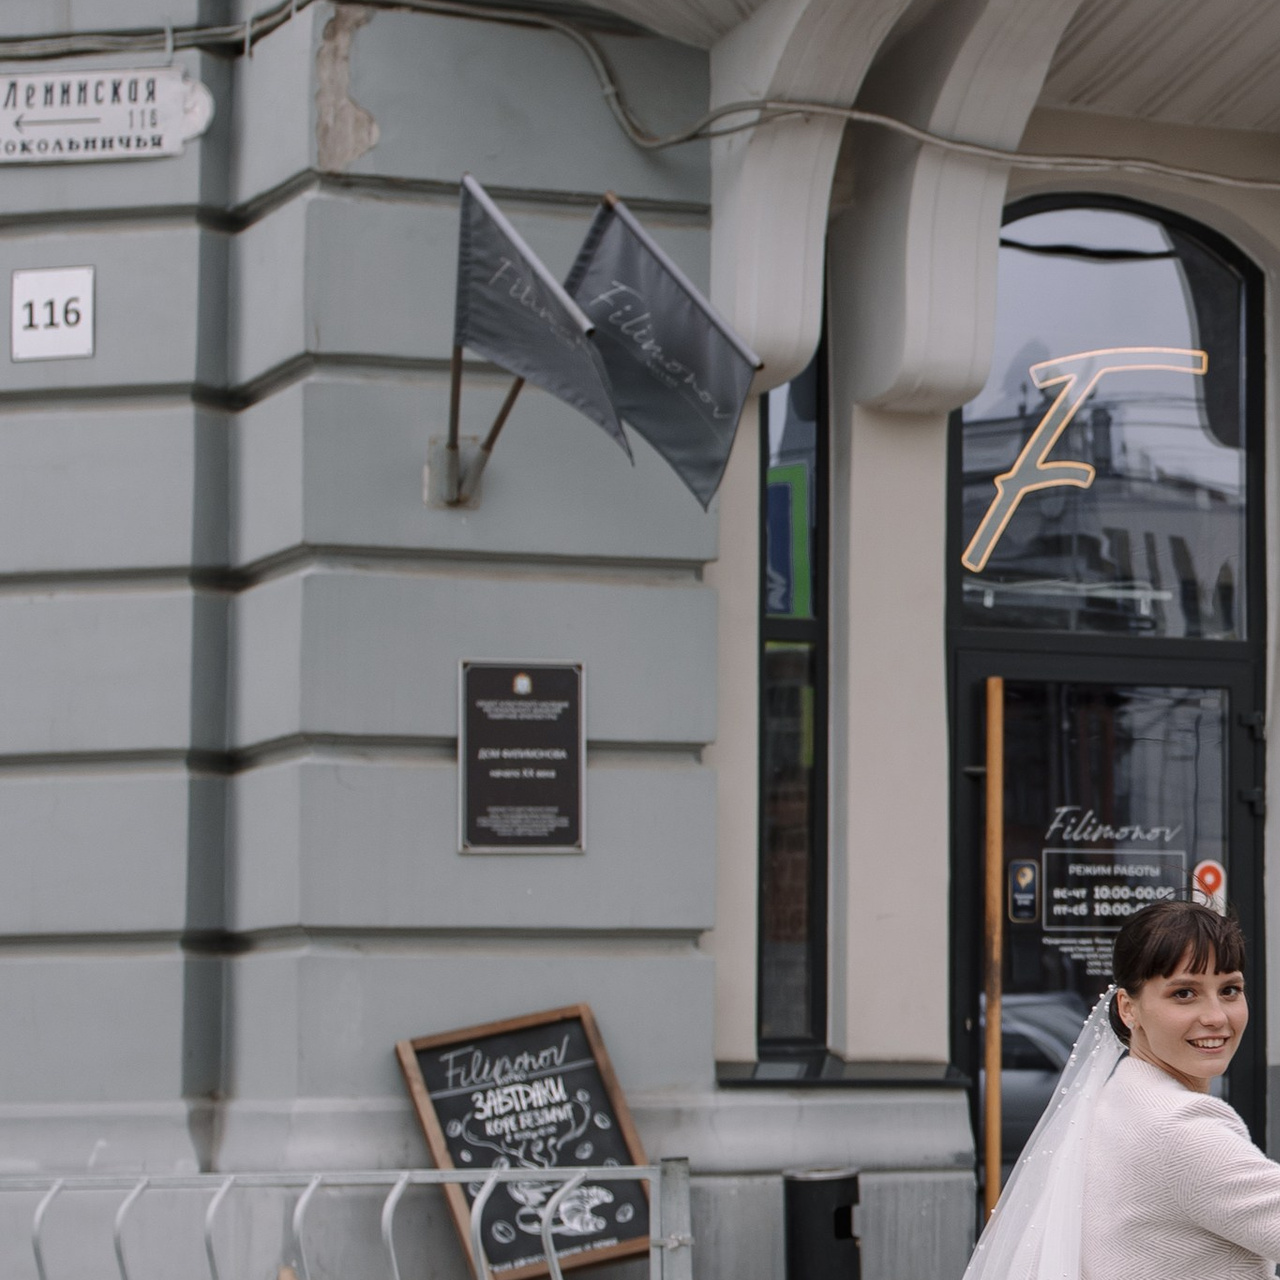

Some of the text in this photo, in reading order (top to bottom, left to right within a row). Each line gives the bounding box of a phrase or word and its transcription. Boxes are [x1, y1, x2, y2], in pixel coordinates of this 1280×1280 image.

[4, 77, 157, 109] Ленинская
[129, 108, 158, 129] 116
[0, 134, 163, 155] окольничья
[22, 297, 82, 330] 116
[589, 280, 732, 418] Filimonov
[962, 347, 1208, 572] F
[1045, 805, 1183, 842] Filimonov
[1068, 864, 1160, 877] РЕЖИМ РАБОТЫ
